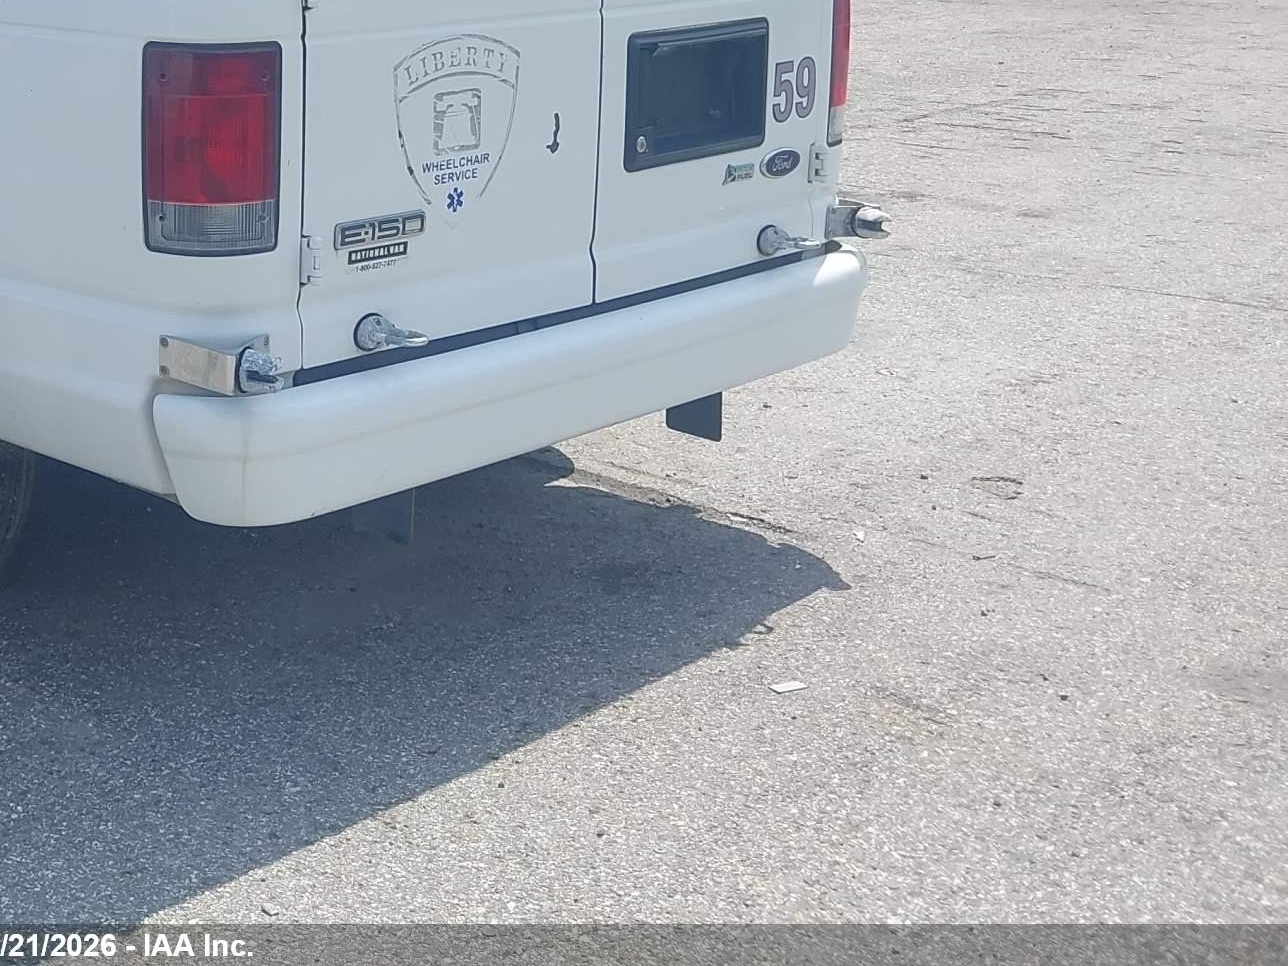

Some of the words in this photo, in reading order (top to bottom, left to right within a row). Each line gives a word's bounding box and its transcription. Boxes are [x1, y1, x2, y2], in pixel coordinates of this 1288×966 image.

[772, 56, 817, 123] 59
[422, 152, 490, 175] WHEELCHAIR
[772, 153, 793, 172] Ford
[433, 167, 479, 186] SERVICE
[350, 246, 389, 262] NATIONAL
